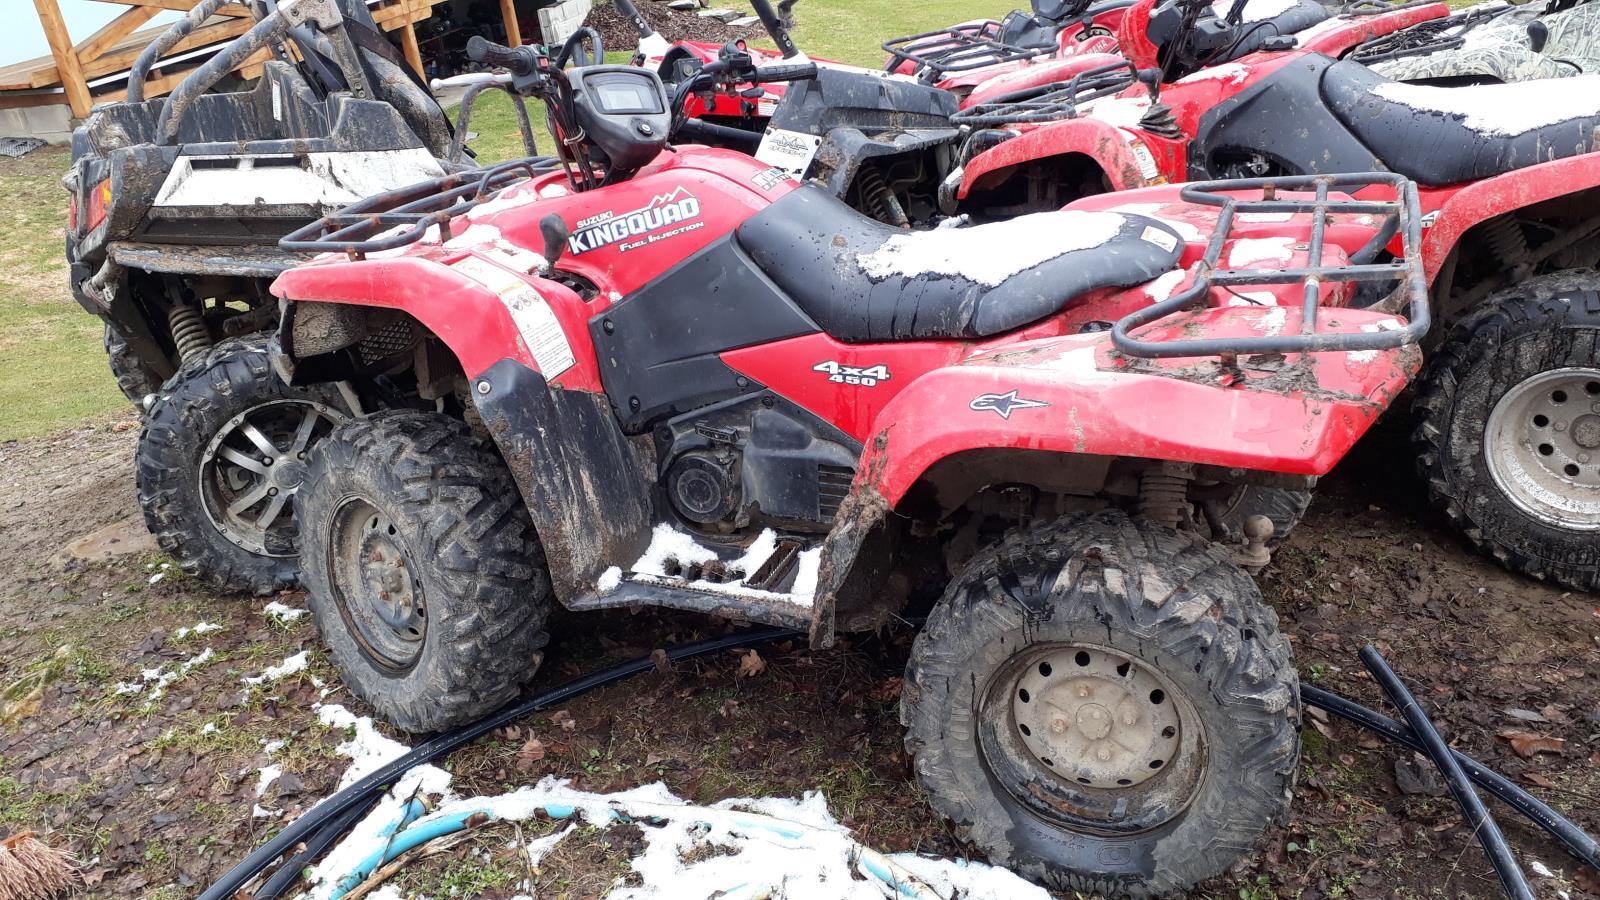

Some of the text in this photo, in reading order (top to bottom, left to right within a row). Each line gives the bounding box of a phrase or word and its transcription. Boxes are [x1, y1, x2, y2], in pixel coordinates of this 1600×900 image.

[568, 197, 700, 255] KINGQUAD
[576, 210, 614, 228] SUZUKI
[828, 374, 877, 387] 450
